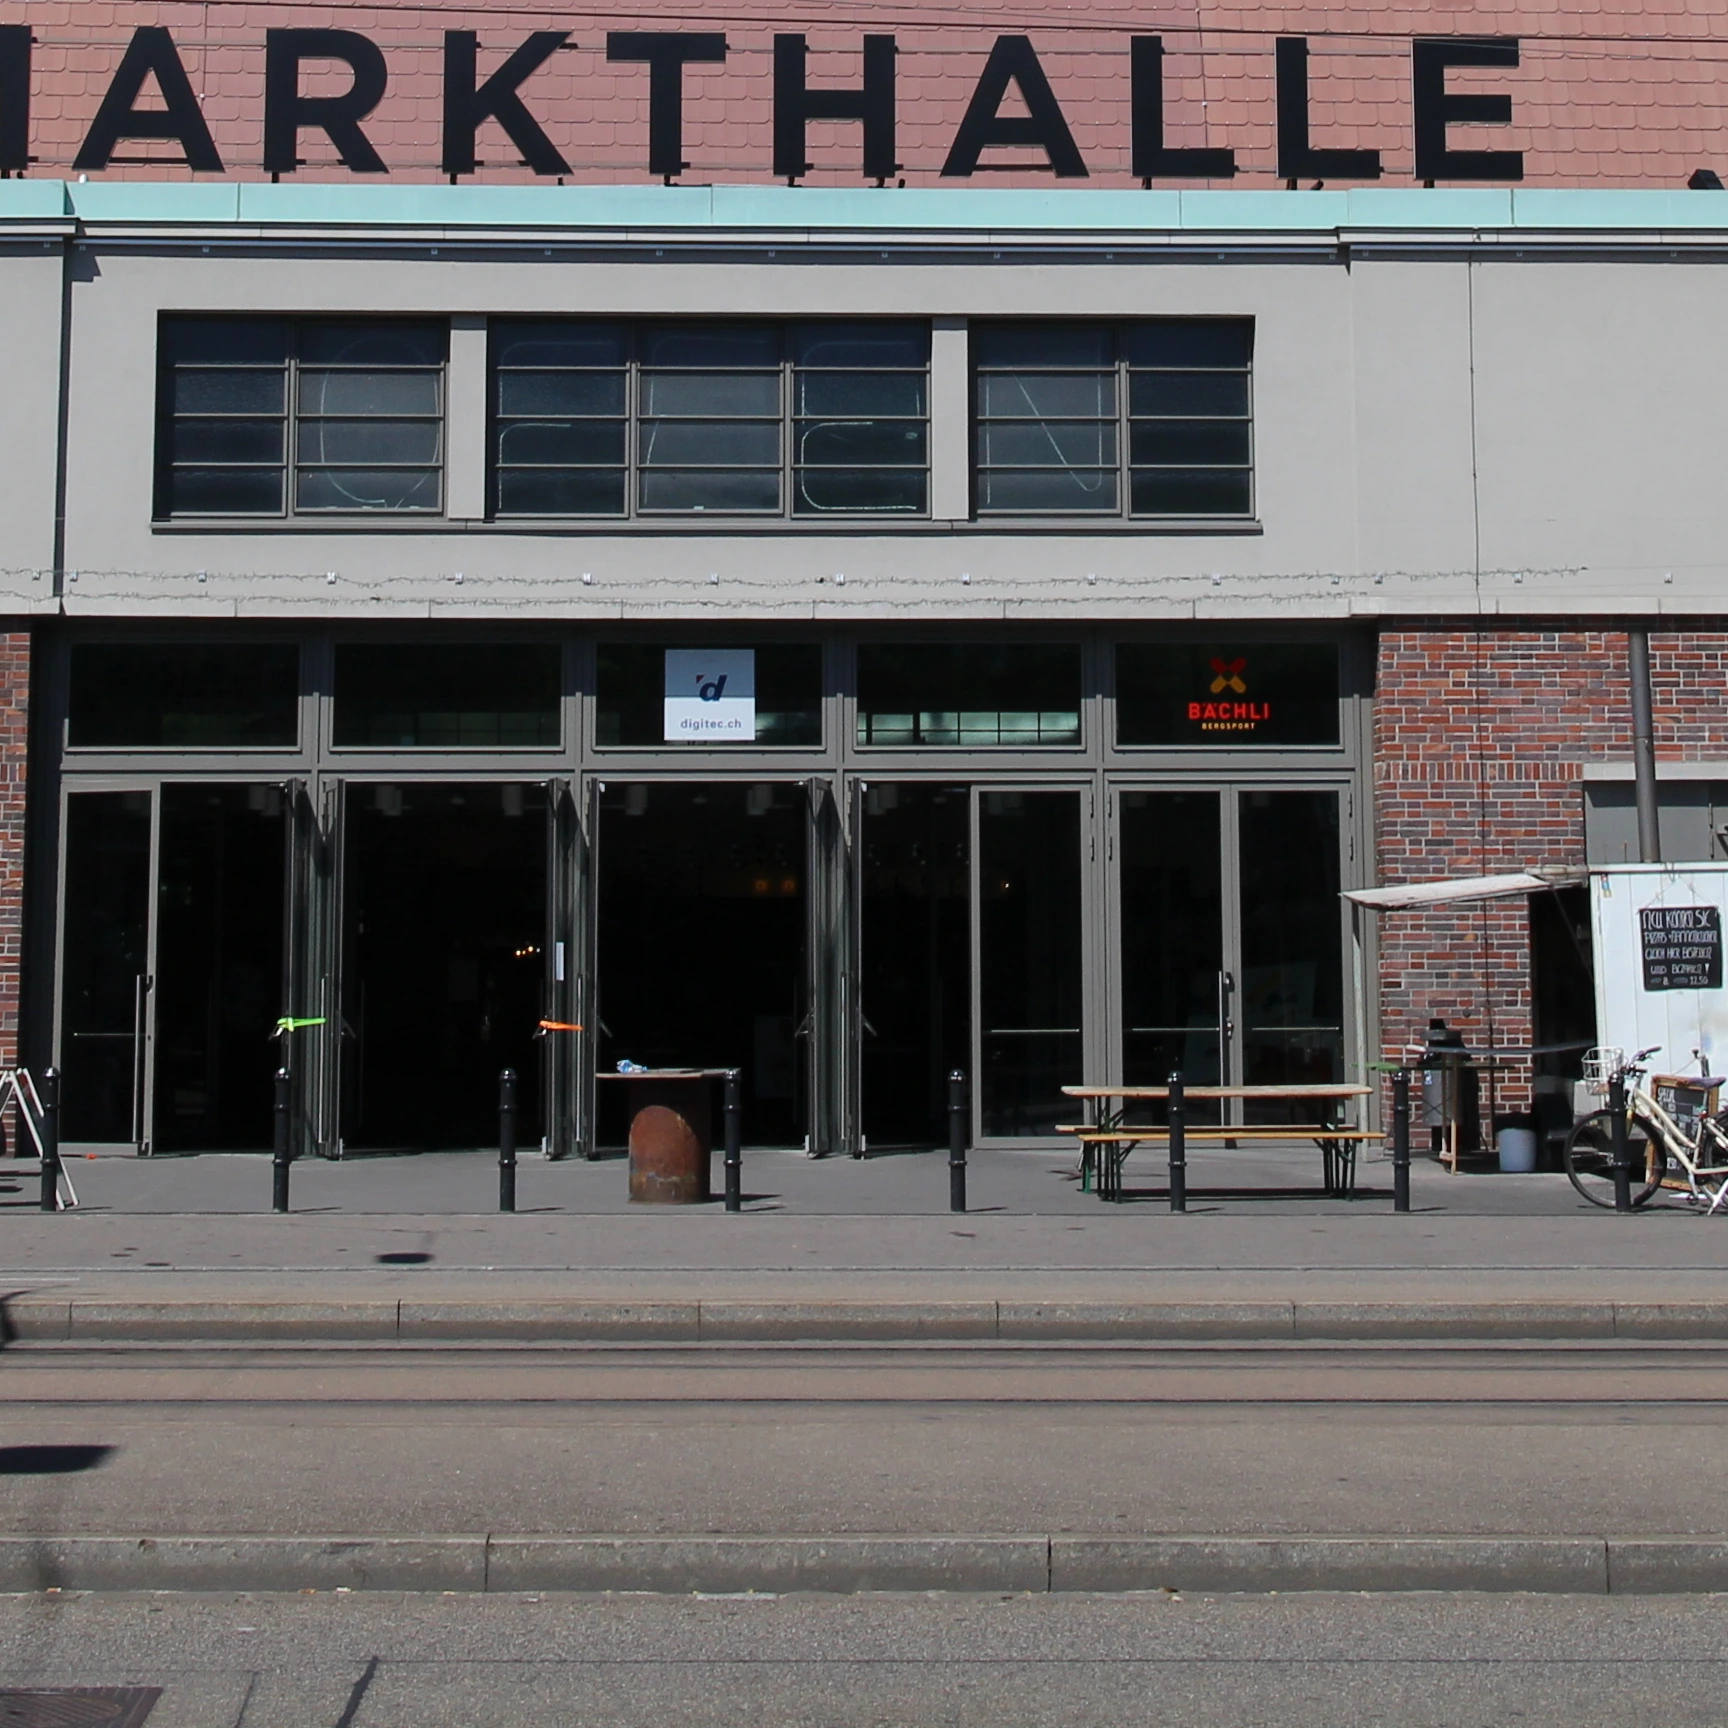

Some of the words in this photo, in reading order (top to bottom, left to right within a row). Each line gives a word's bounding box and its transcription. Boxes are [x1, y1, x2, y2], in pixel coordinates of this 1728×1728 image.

[1188, 702, 1269, 720] BÄCHLI
[680, 717, 742, 730] digitec.ch
[1201, 722, 1255, 730] BERGSPORT
